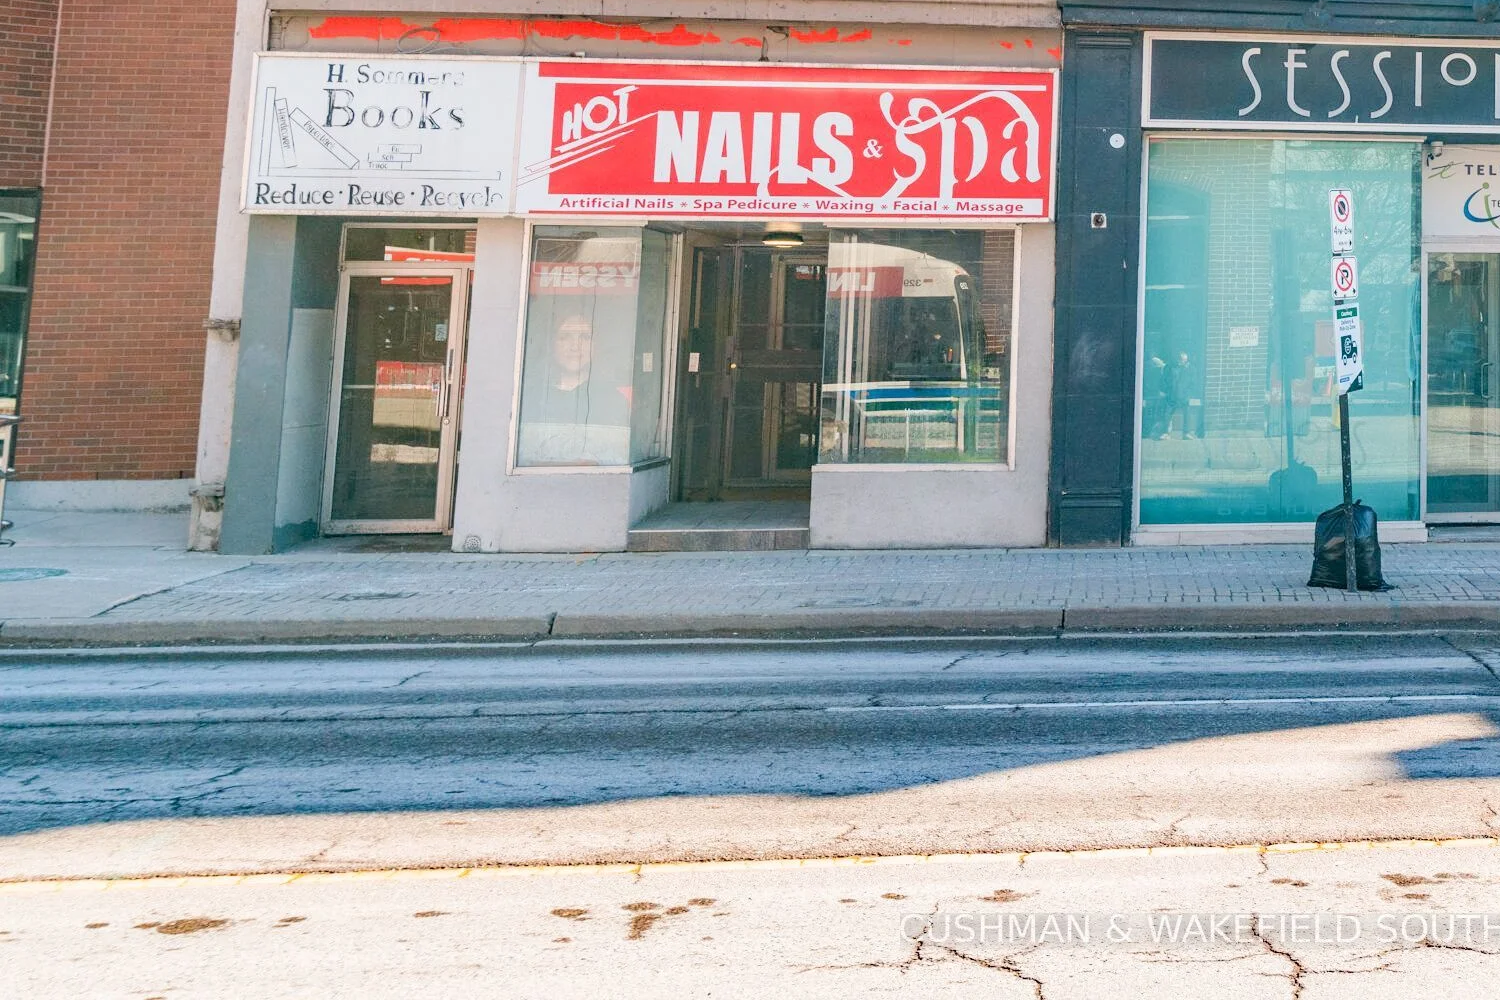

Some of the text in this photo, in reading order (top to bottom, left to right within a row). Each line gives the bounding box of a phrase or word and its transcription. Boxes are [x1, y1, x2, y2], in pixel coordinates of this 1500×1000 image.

[322, 88, 465, 130] Books
[562, 85, 639, 141] HOT
[654, 111, 854, 185] NAILS
[863, 138, 884, 159] &
[254, 182, 334, 206] Reduce
[347, 183, 405, 206] Reuse
[560, 197, 1024, 212] Artificial Nails Spa Pedicure Waxing Facial Massage
